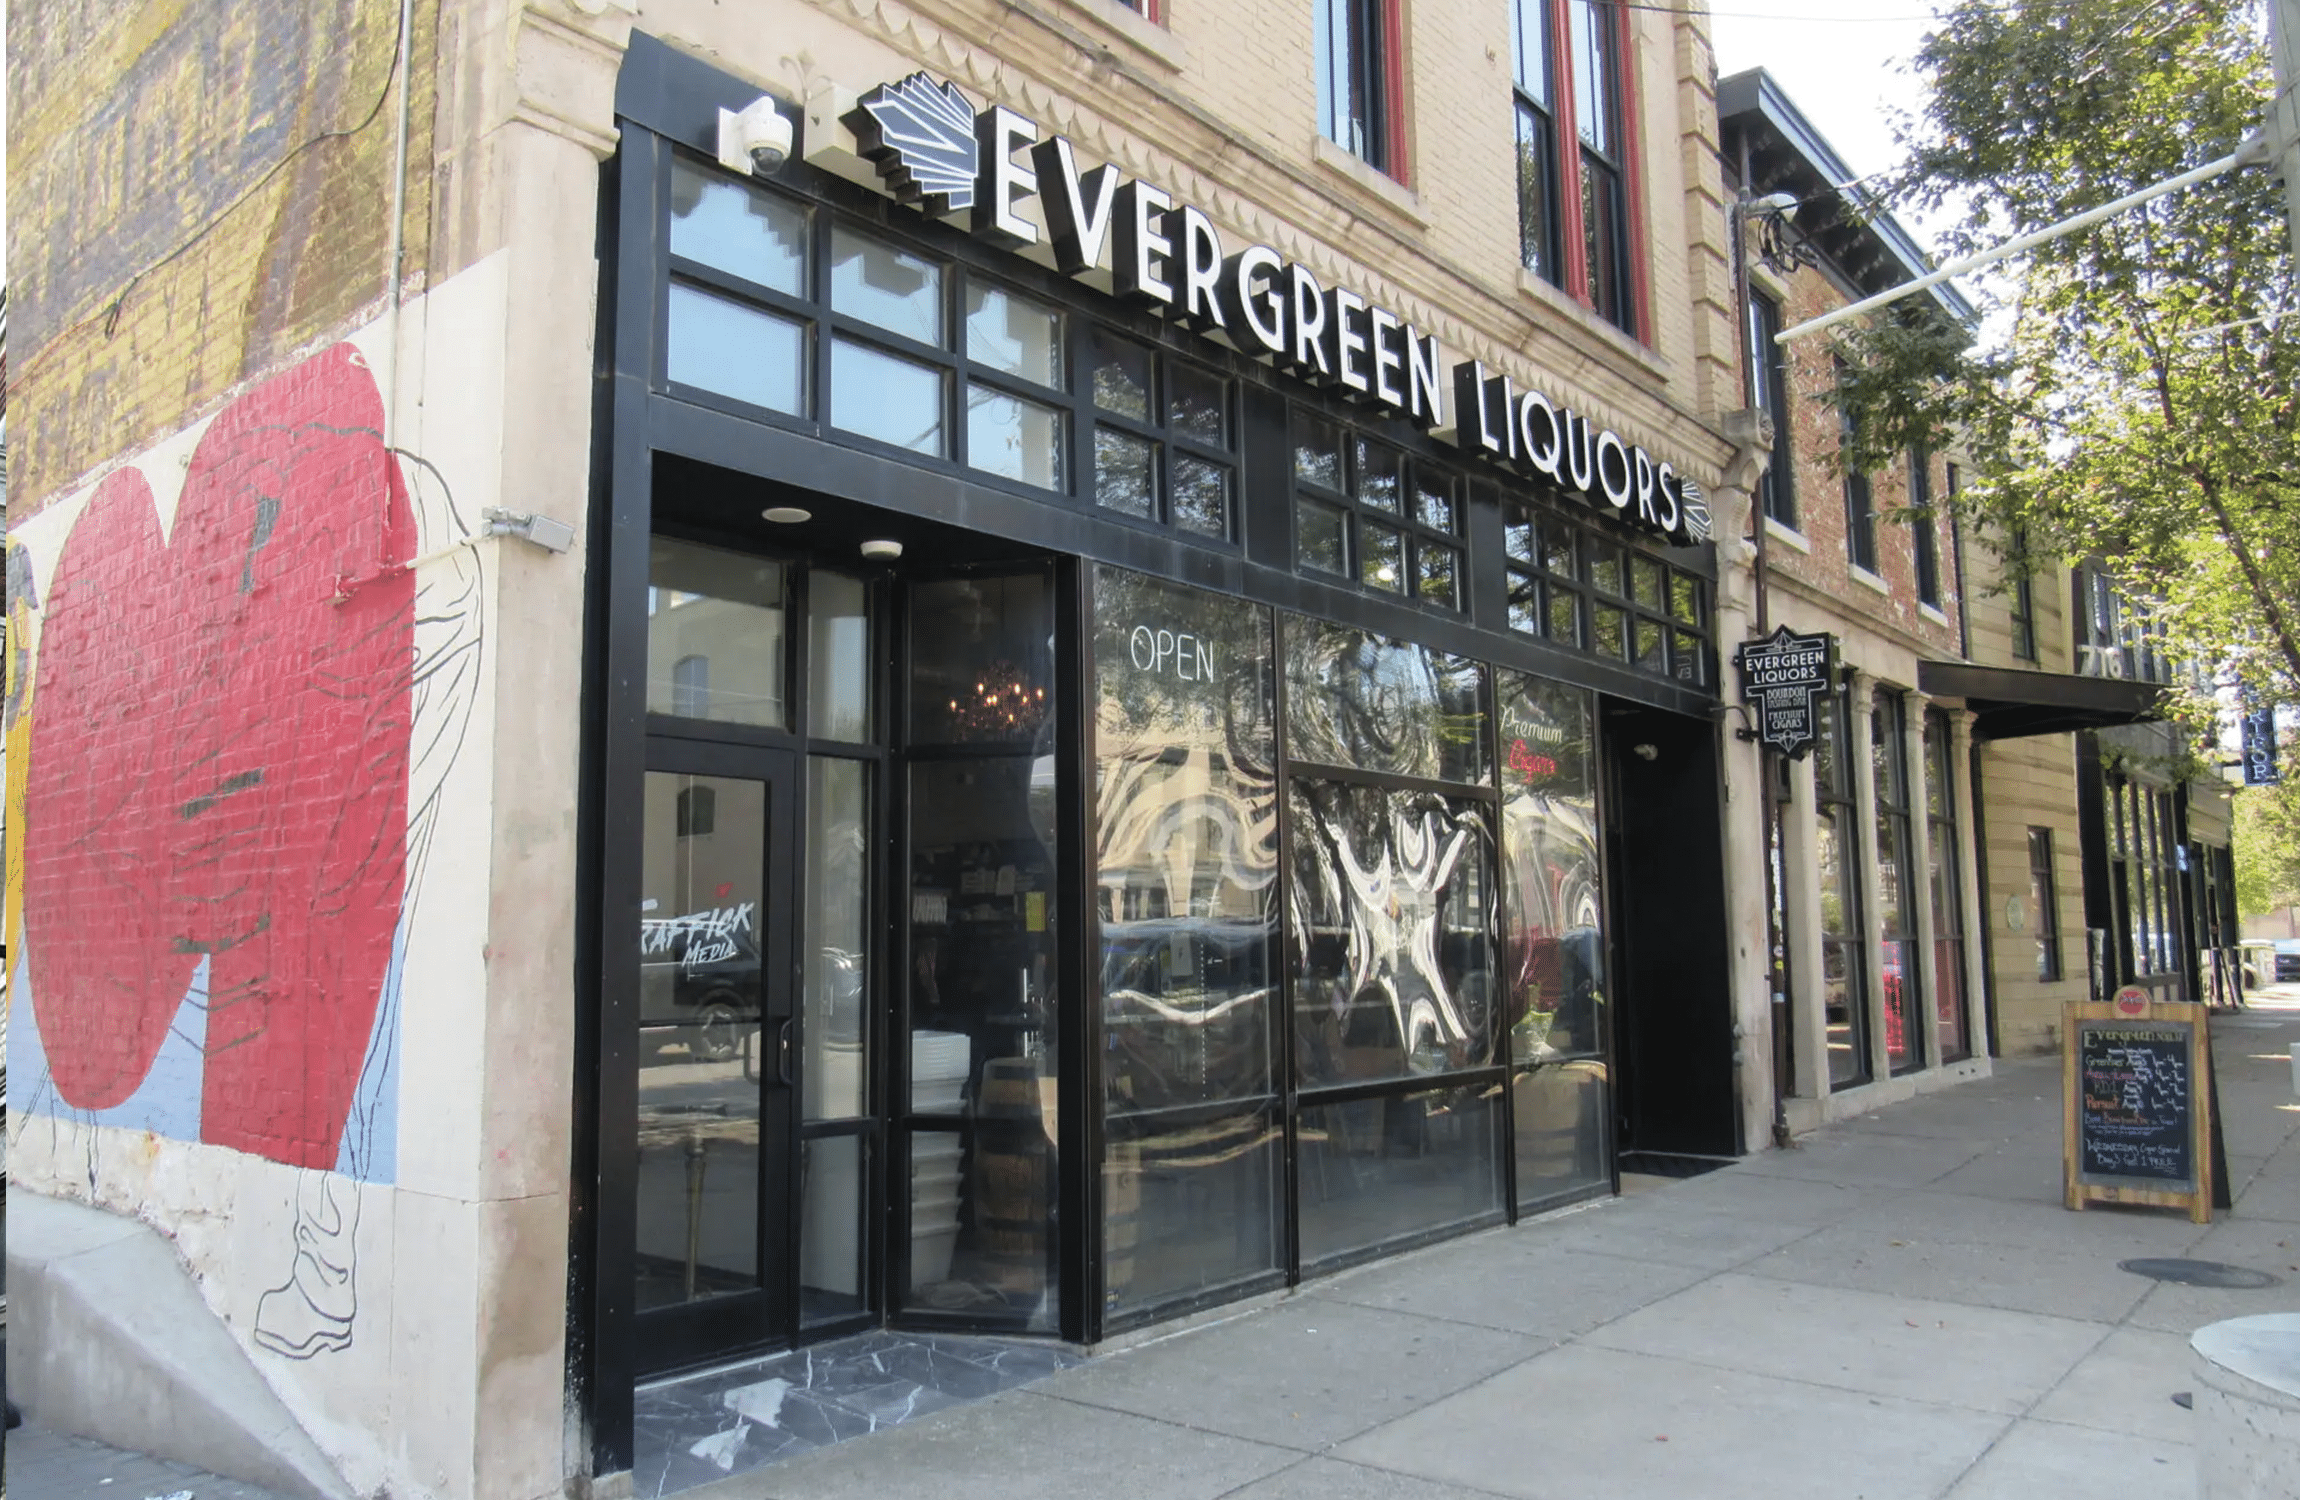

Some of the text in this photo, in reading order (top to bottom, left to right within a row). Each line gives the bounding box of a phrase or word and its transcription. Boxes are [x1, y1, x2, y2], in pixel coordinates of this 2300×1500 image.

[990, 104, 1682, 532] EVERGREEN LIQUORS
[1131, 626, 1213, 683] OPEN
[1746, 651, 1824, 671] EVERGREEN
[1754, 666, 1816, 684] LIQUORS
[1766, 686, 1806, 700] BOURBON
[1500, 704, 1563, 743] Premium
[1768, 708, 1806, 721] PREMIUM
[1772, 718, 1802, 730] CIGARS
[642, 899, 756, 955] RAFFICK
